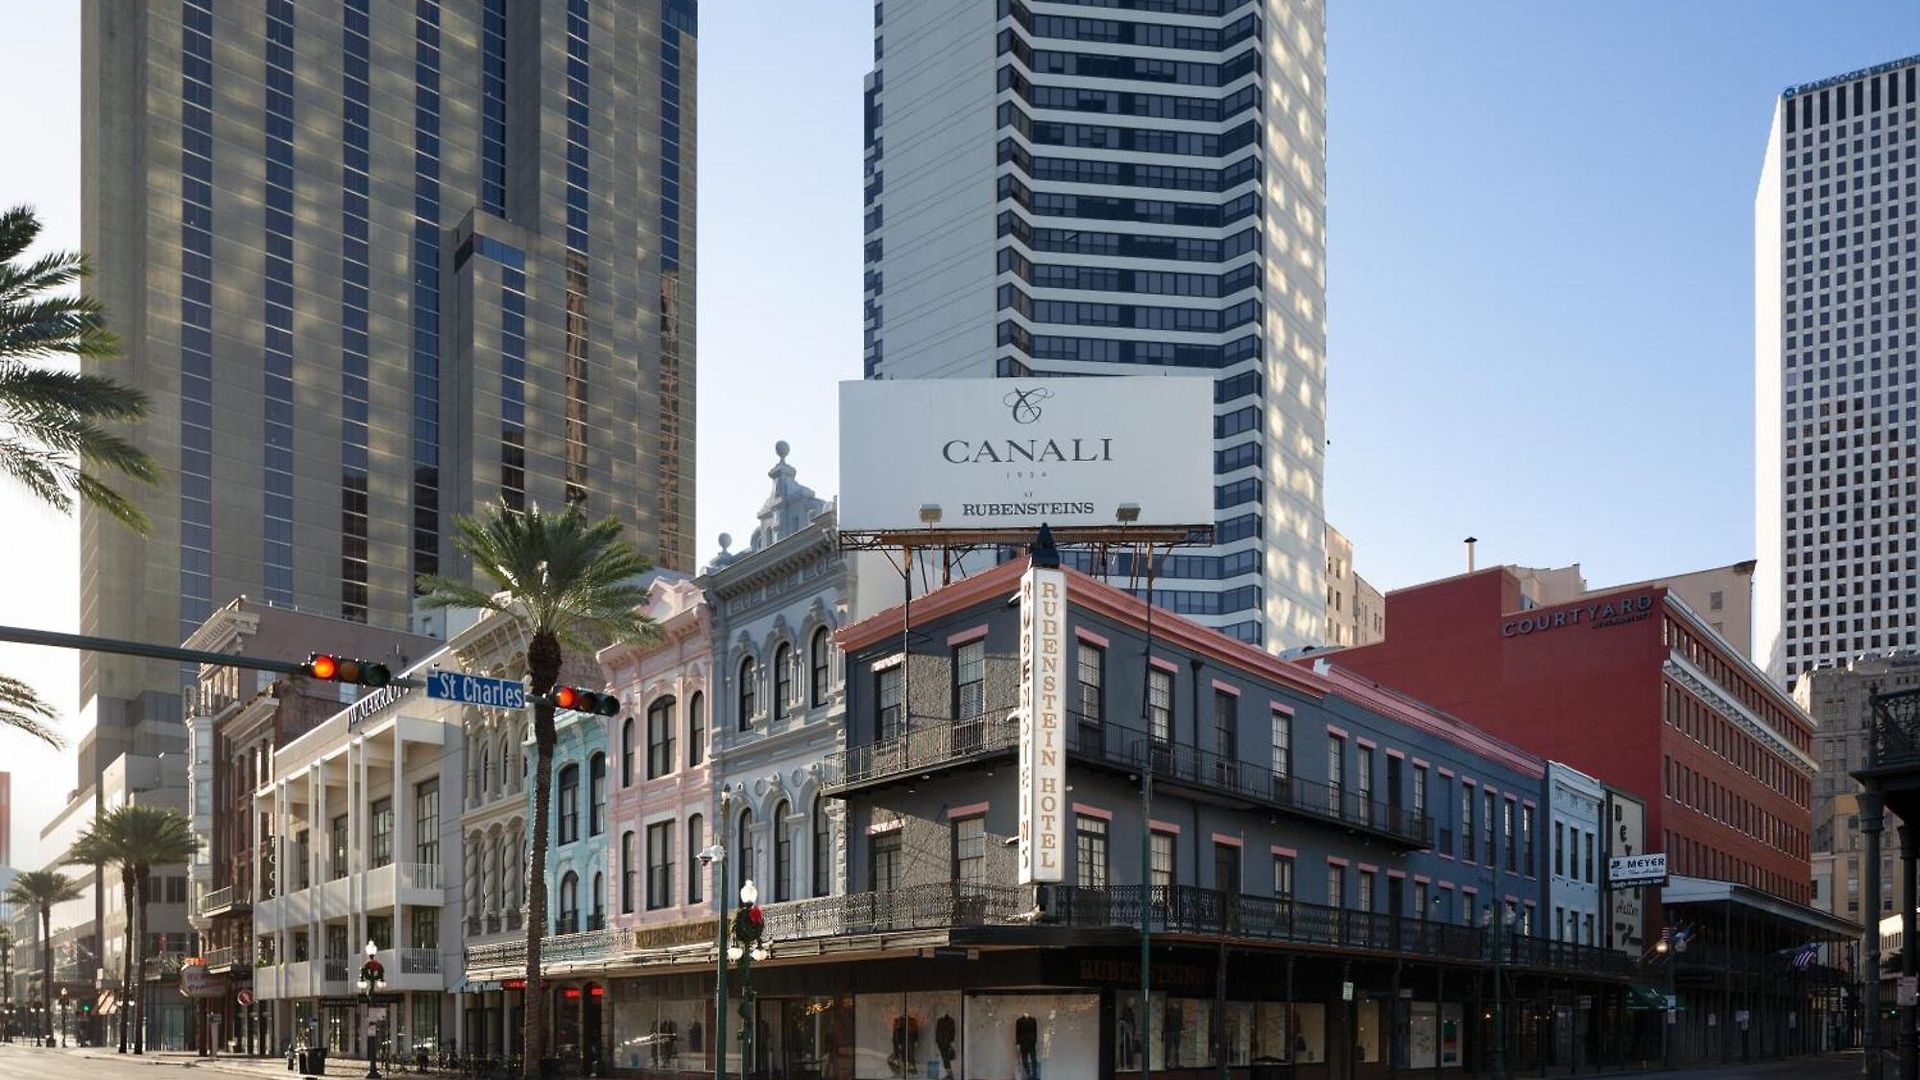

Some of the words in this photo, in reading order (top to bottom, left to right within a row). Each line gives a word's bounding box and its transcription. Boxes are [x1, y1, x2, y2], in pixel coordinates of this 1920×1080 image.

[942, 438, 1113, 464] CANALI
[962, 502, 1095, 517] RUBENSTEINS
[1502, 595, 1654, 638] COURTYARD
[440, 672, 457, 700] St
[462, 676, 523, 709] Charles
[1041, 581, 1059, 766] RUBENSTEIN
[1041, 777, 1057, 868] HOTEL
[1627, 857, 1665, 869] MEYER
